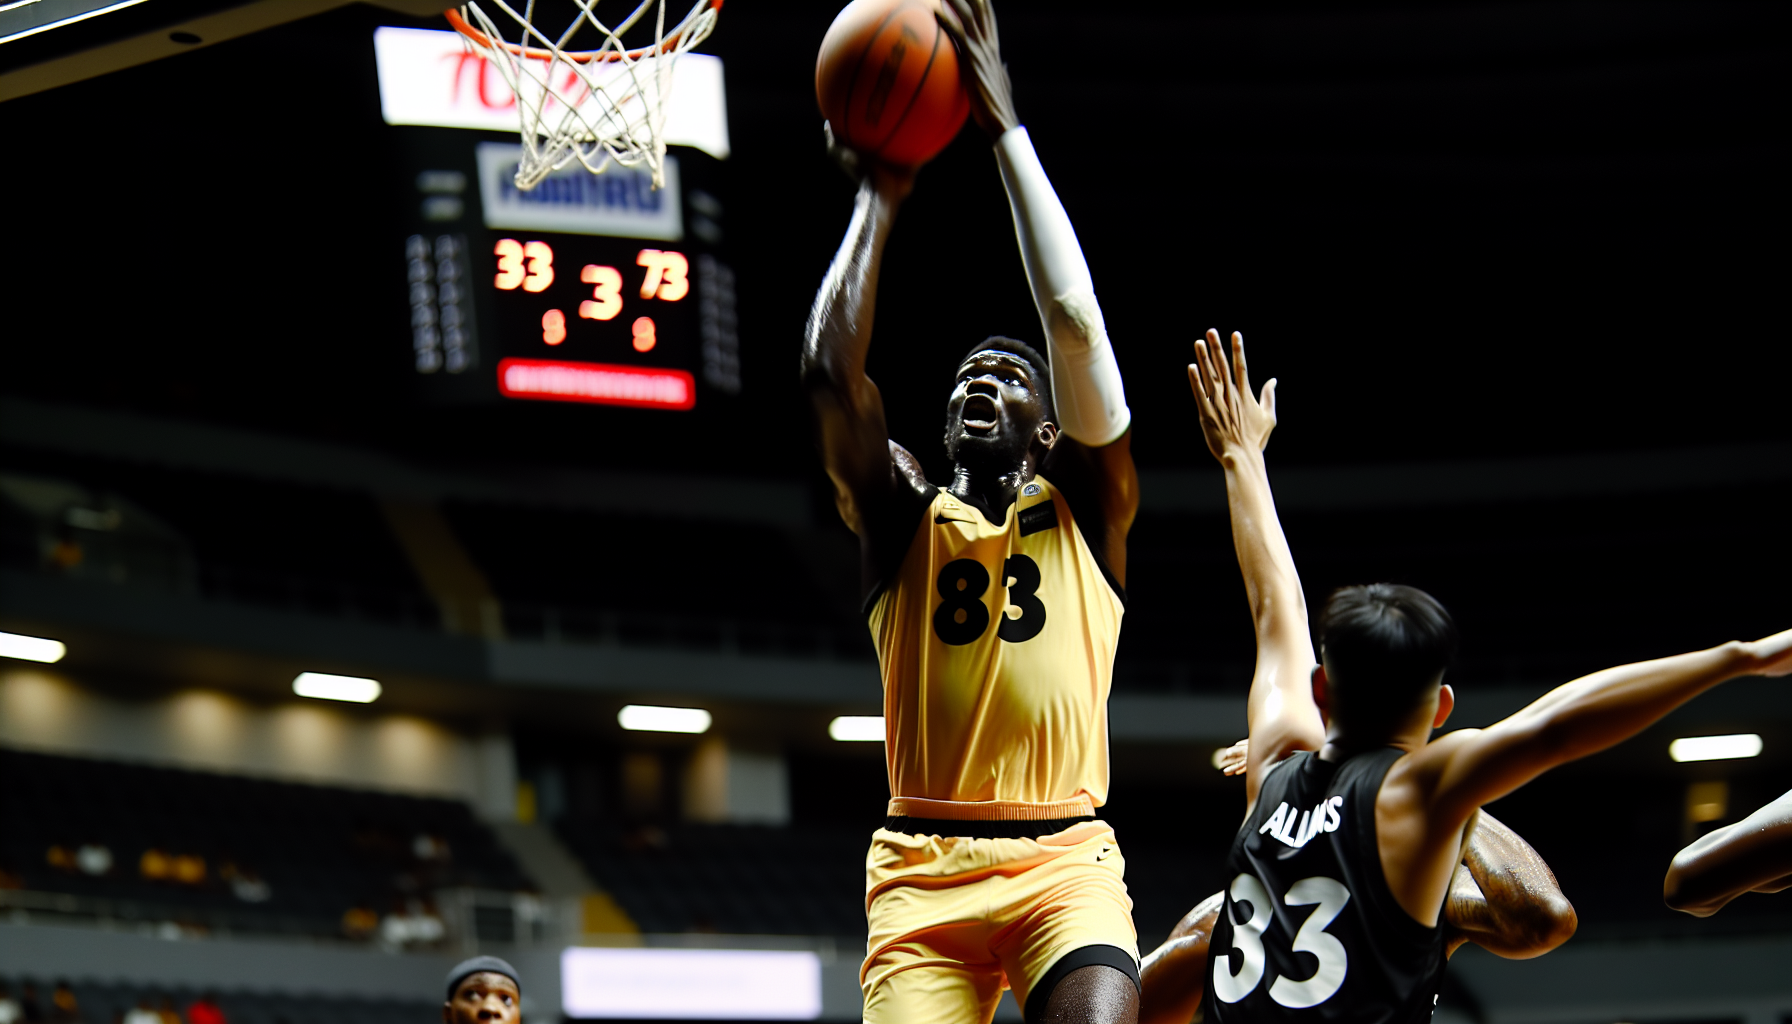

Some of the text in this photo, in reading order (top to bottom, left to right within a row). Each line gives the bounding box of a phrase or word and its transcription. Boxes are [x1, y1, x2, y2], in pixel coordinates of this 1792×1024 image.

[494, 238, 554, 293] 33
[579, 264, 623, 321] 3
[636, 248, 689, 302] 73
[933, 554, 1046, 646] 83
[1213, 873, 1350, 1008] 33
